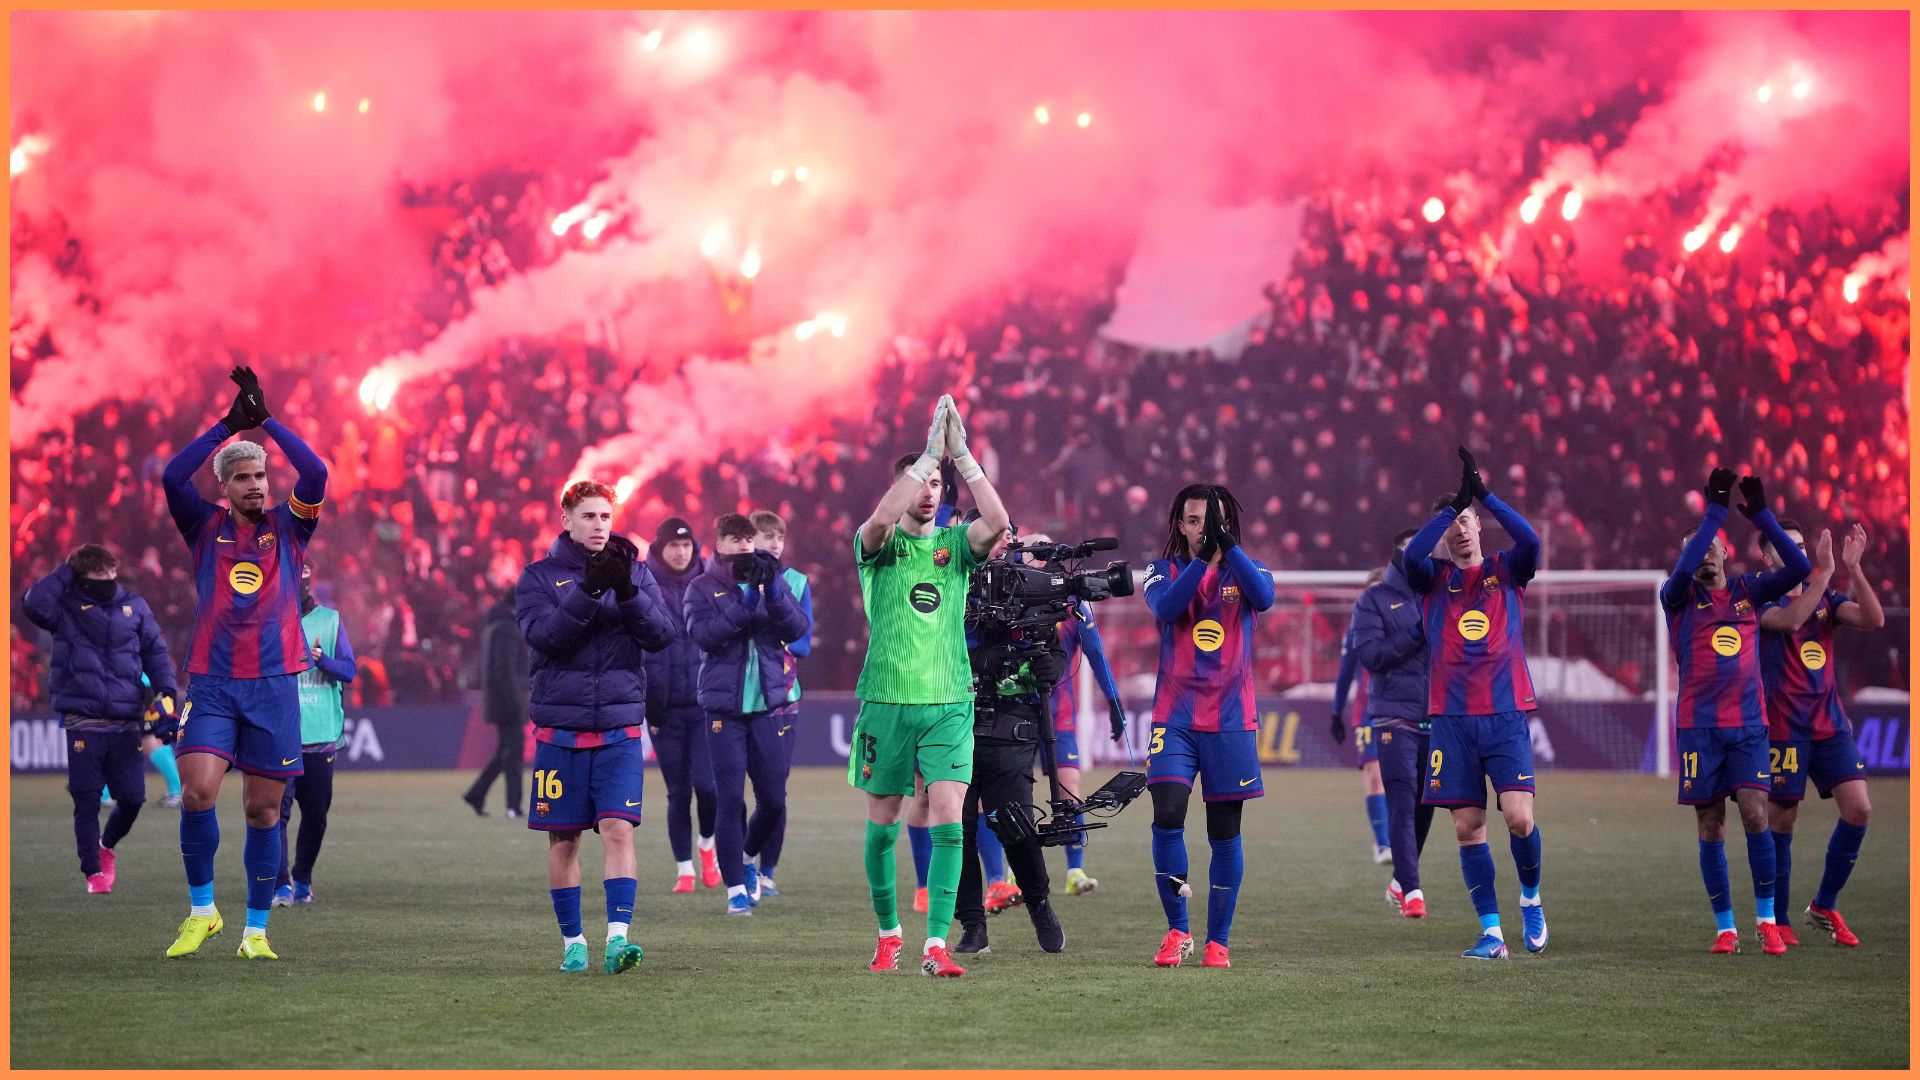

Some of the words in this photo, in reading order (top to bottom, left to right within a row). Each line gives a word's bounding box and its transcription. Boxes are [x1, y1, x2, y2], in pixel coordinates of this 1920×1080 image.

[860, 732, 877, 763] 13
[1855, 716, 1910, 769] AL
[1430, 749, 1443, 777] 9
[1683, 751, 1698, 778] 11
[1769, 747, 1799, 773] 24
[534, 769, 563, 799] 16
